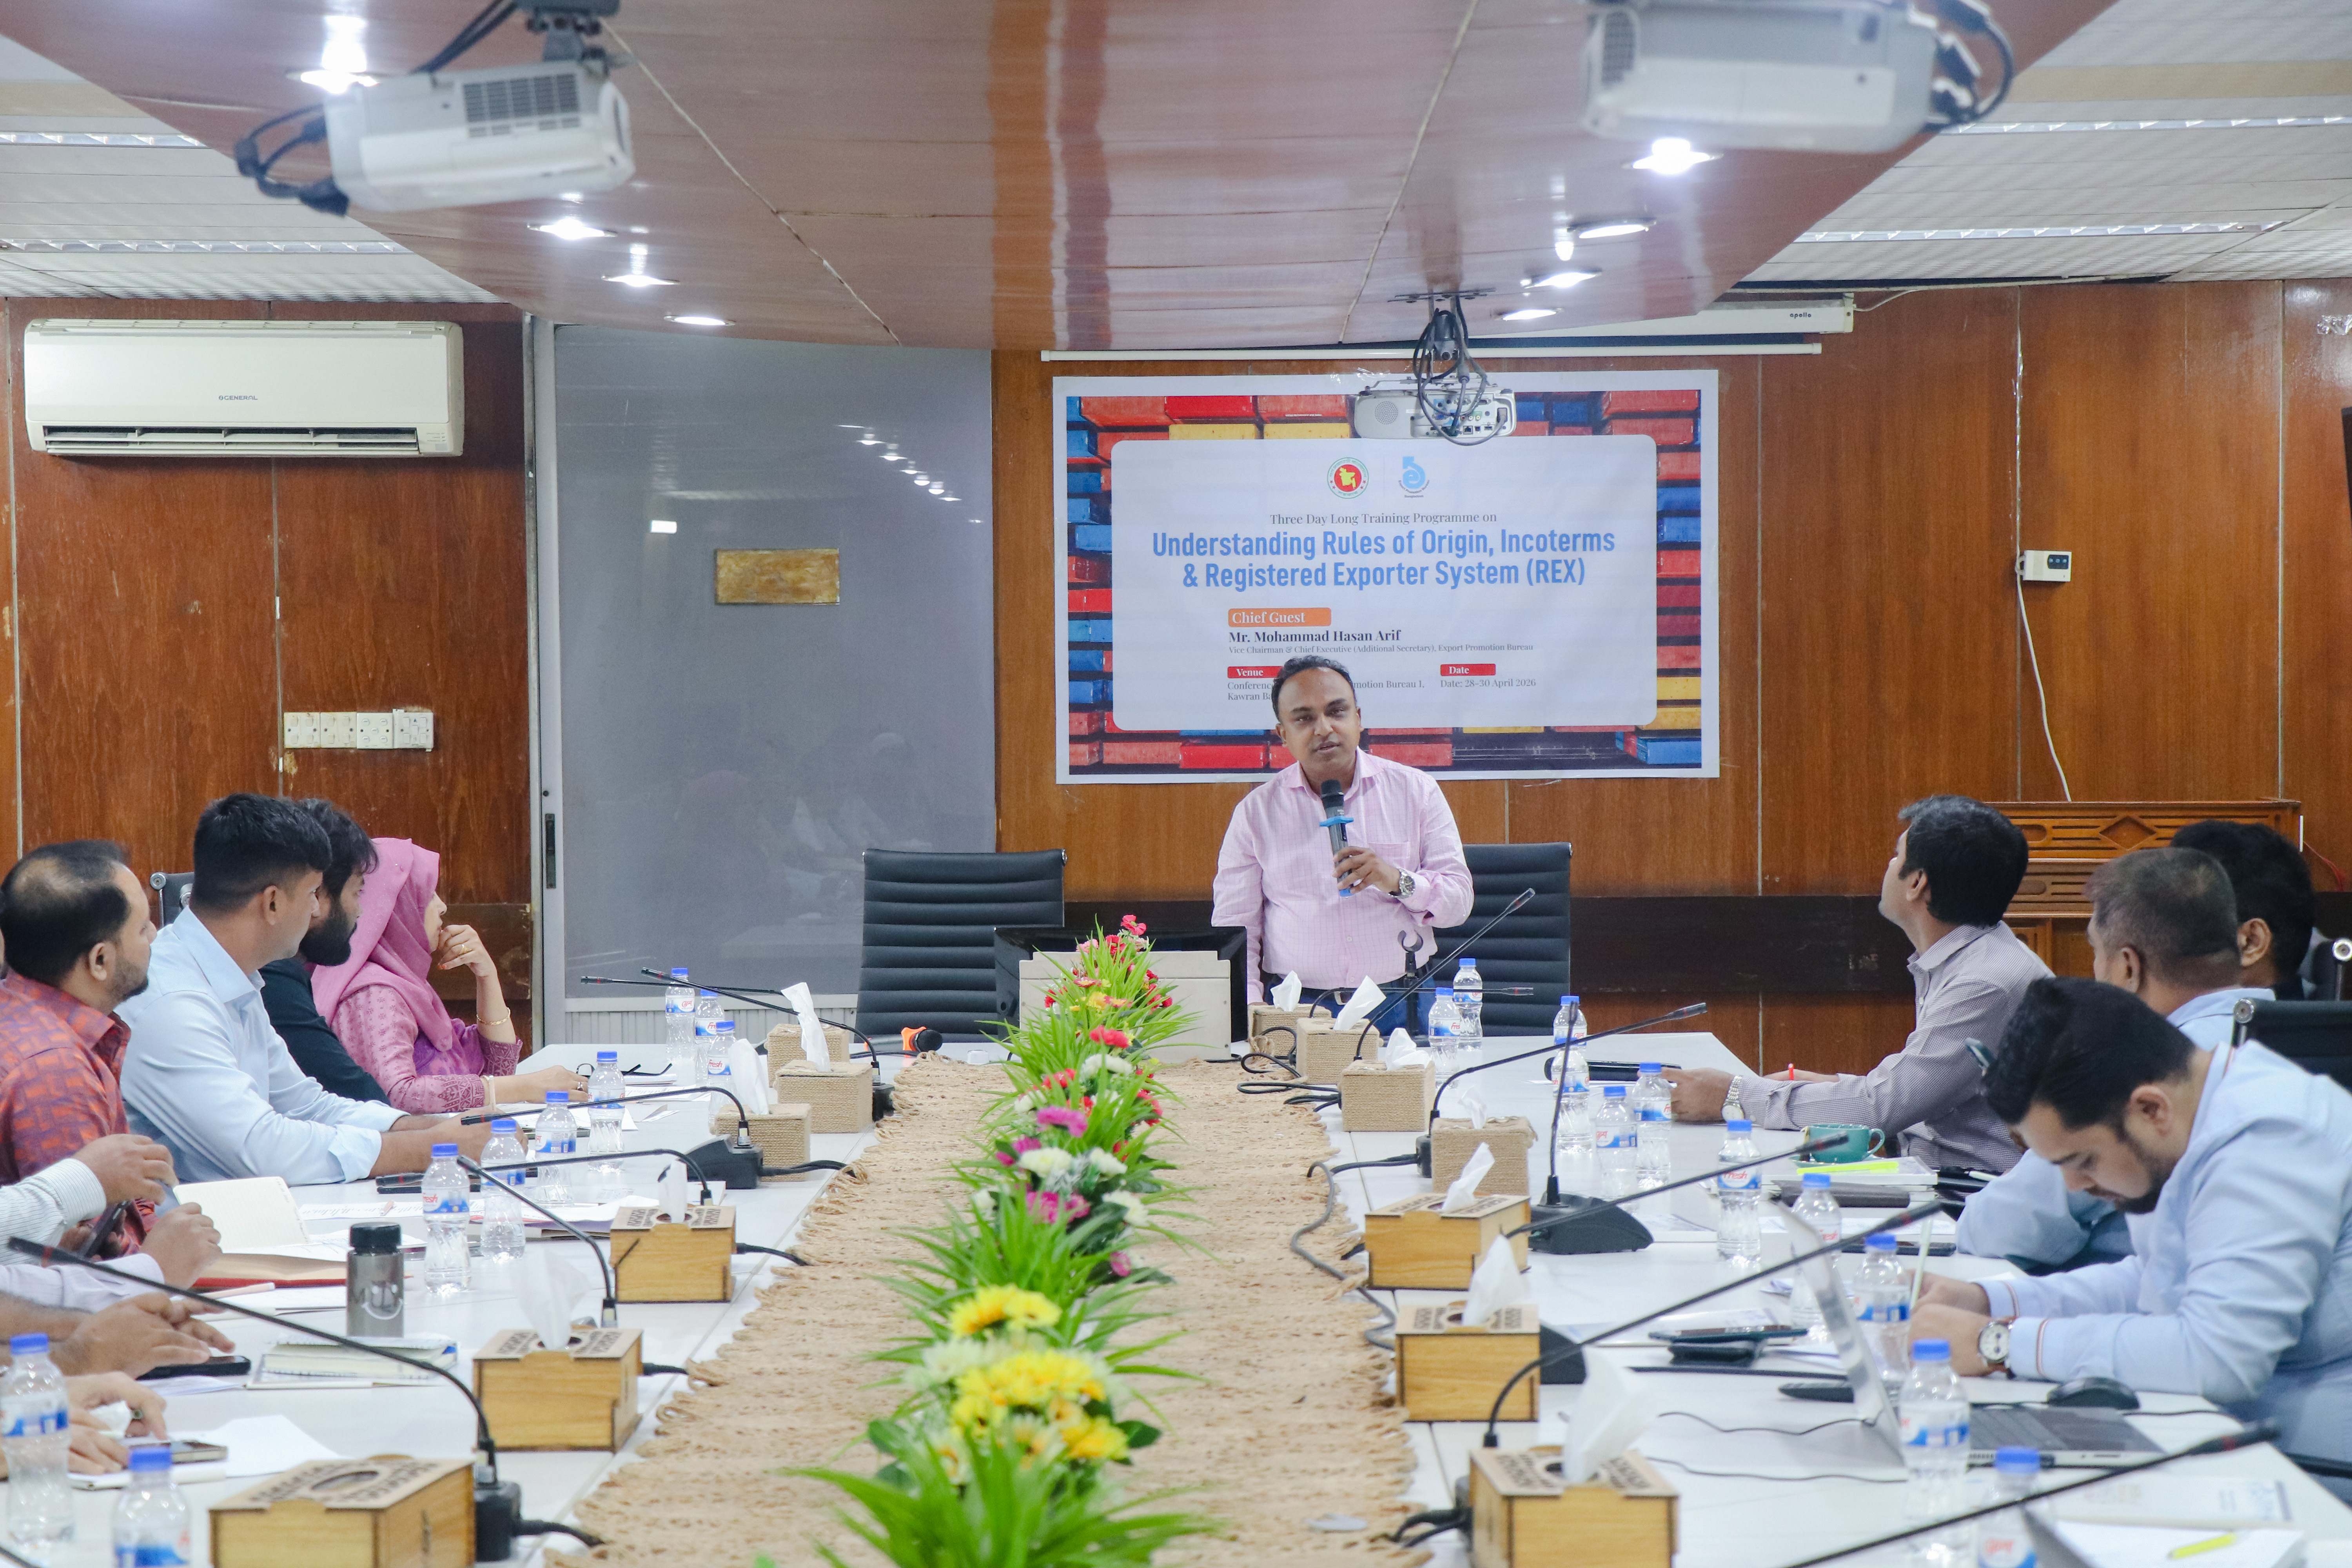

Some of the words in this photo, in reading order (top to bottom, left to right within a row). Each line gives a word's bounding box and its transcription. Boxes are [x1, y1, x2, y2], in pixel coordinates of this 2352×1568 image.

[1270, 514, 1303, 524] Three
[1307, 514, 1327, 526] Day
[1331, 514, 1358, 525] Long
[1361, 513, 1410, 524] Training
[1414, 513, 1479, 524] Programme
[1153, 532, 1315, 561] Understanding
[1323, 531, 1385, 555] Rules
[1393, 530, 1415, 554] of
[1422, 530, 1494, 559] Origin,
[1501, 529, 1615, 553] Incoterms
[1183, 563, 1198, 587] &
[1206, 563, 1326, 592] Registered
[1334, 562, 1429, 591] Exporter
[1436, 561, 1519, 590] System
[1526, 558, 1585, 586] (REX)
[1232, 612, 1267, 623] Chief
[1269, 612, 1305, 623] Guest
[1229, 632, 1250, 642] Mr.
[1254, 630, 1329, 642] Mohammad
[1334, 631, 1372, 641] Hasan
[1376, 630, 1401, 641] Arif
[1354, 645, 1394, 653] (Additional
[1492, 679, 1513, 688] April
[1663, 1103, 1672, 1112] Fre
